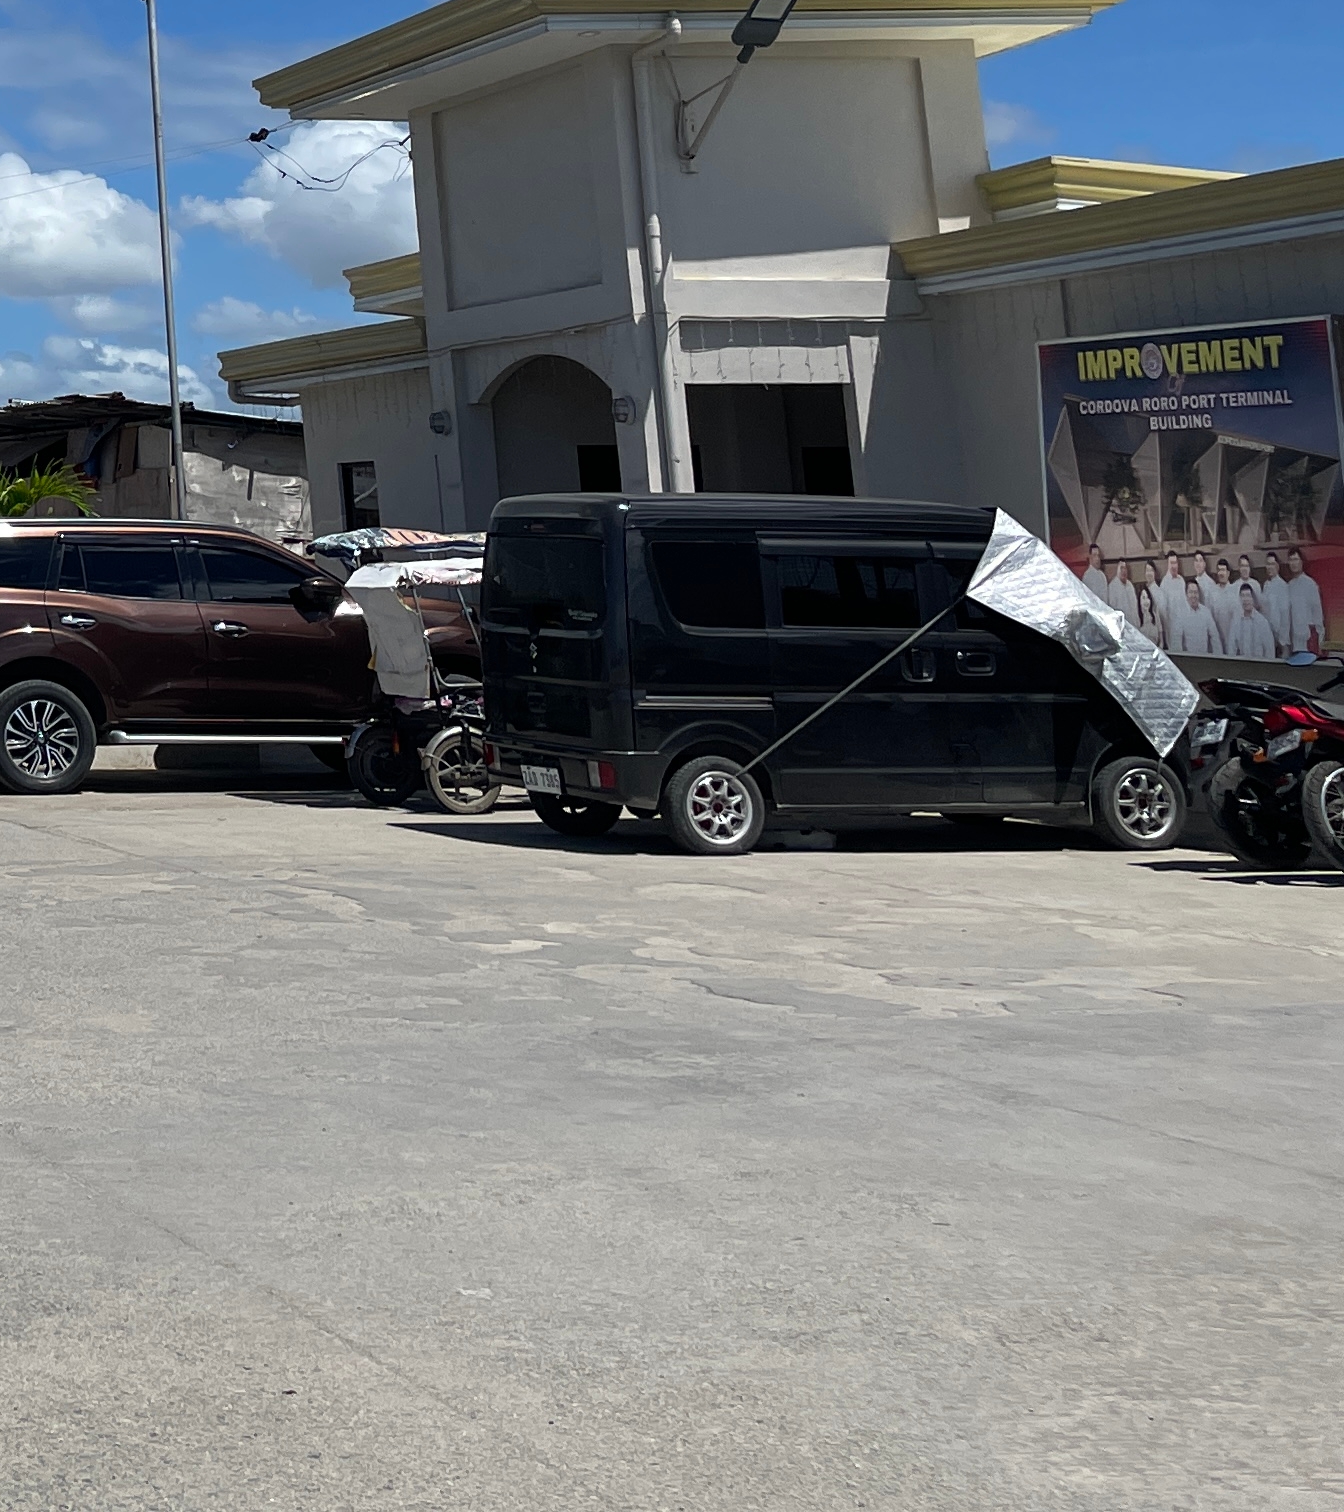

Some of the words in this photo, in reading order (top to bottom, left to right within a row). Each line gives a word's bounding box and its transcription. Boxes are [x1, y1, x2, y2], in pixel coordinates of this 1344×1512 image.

[1079, 399, 1139, 415] CORDOVA
[1142, 397, 1179, 412] RORO
[1181, 394, 1217, 409] PORT
[1219, 390, 1293, 408] TERMINAL
[1150, 413, 1213, 431] BUILDING
